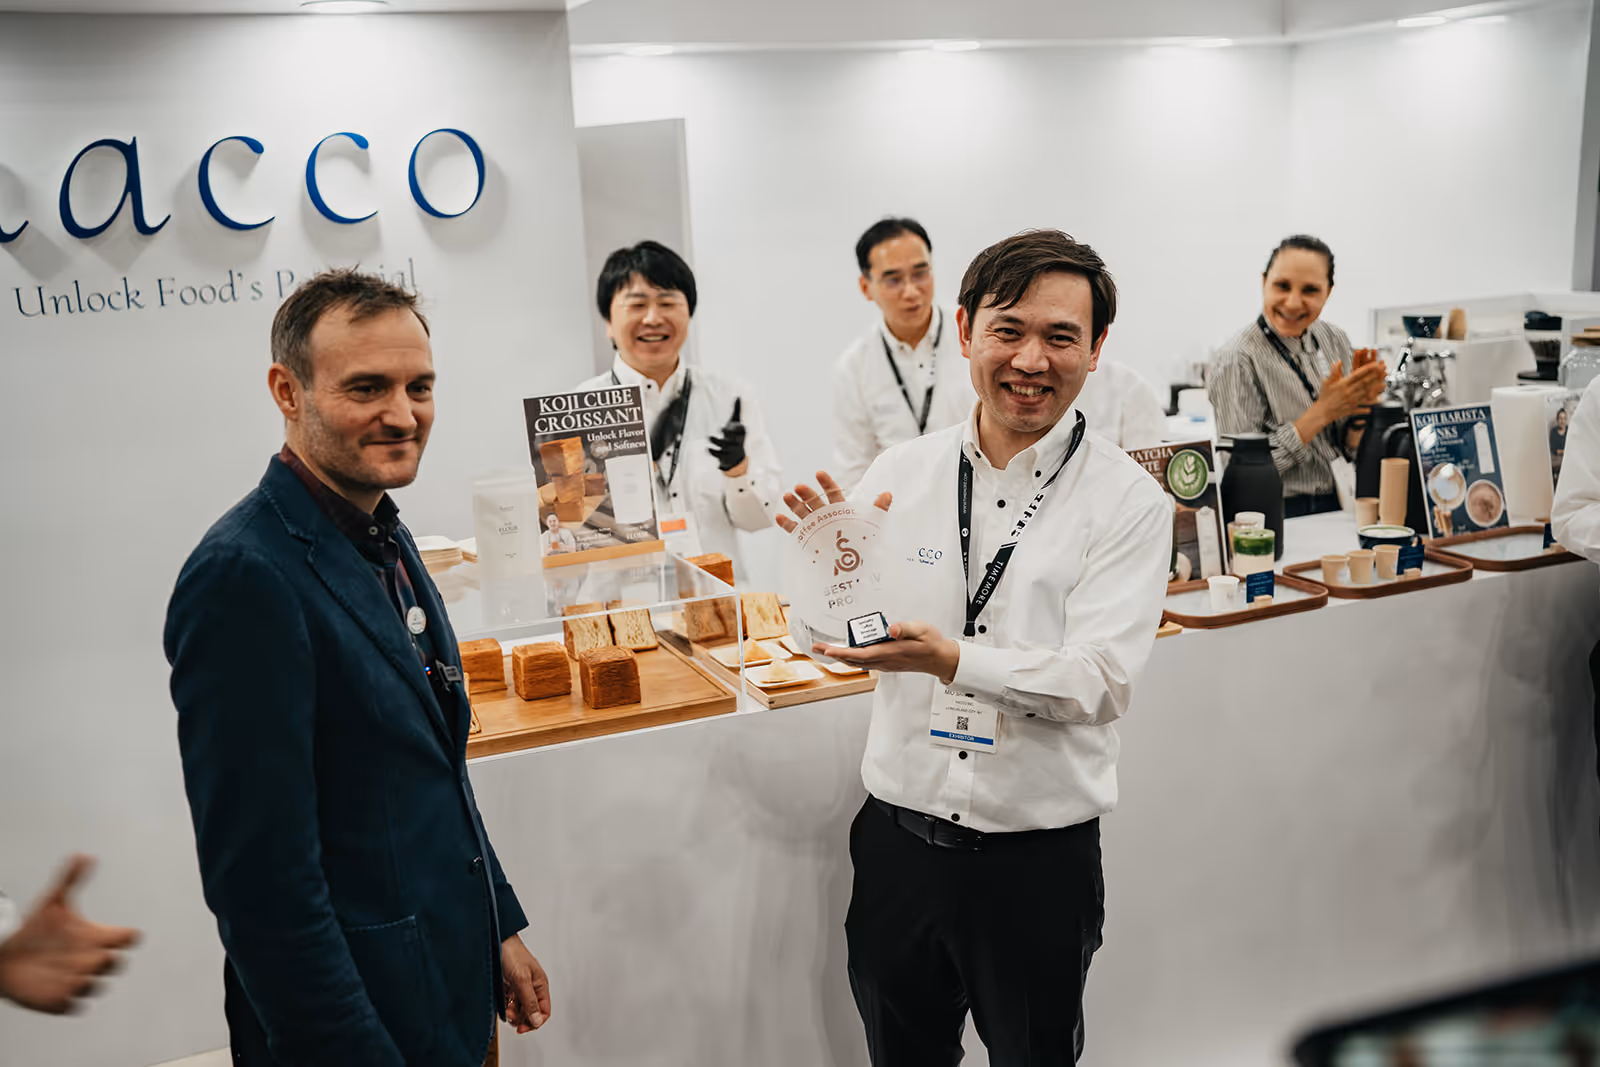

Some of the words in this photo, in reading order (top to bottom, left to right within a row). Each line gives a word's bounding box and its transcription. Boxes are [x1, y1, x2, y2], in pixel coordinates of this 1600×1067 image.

[0, 128, 486, 243] acco
[13, 277, 146, 317] Unlock
[157, 269, 264, 307] Food's
[539, 395, 579, 413] KOJI
[583, 388, 633, 408] CUBE
[534, 406, 641, 433] CROISSANT
[1440, 408, 1486, 422] BARISTA
[587, 430, 617, 442] Unlock
[619, 428, 645, 439] Flavor
[1436, 426, 1458, 438] NKS
[613, 441, 646, 451] Softness
[1141, 460, 1160, 472] TTE
[797, 521, 816, 544] offee
[918, 547, 943, 560] cco
[975, 561, 1004, 605] TIMEMORE
[828, 595, 854, 609] PRO
[948, 733, 975, 742] EXHIBITOR
